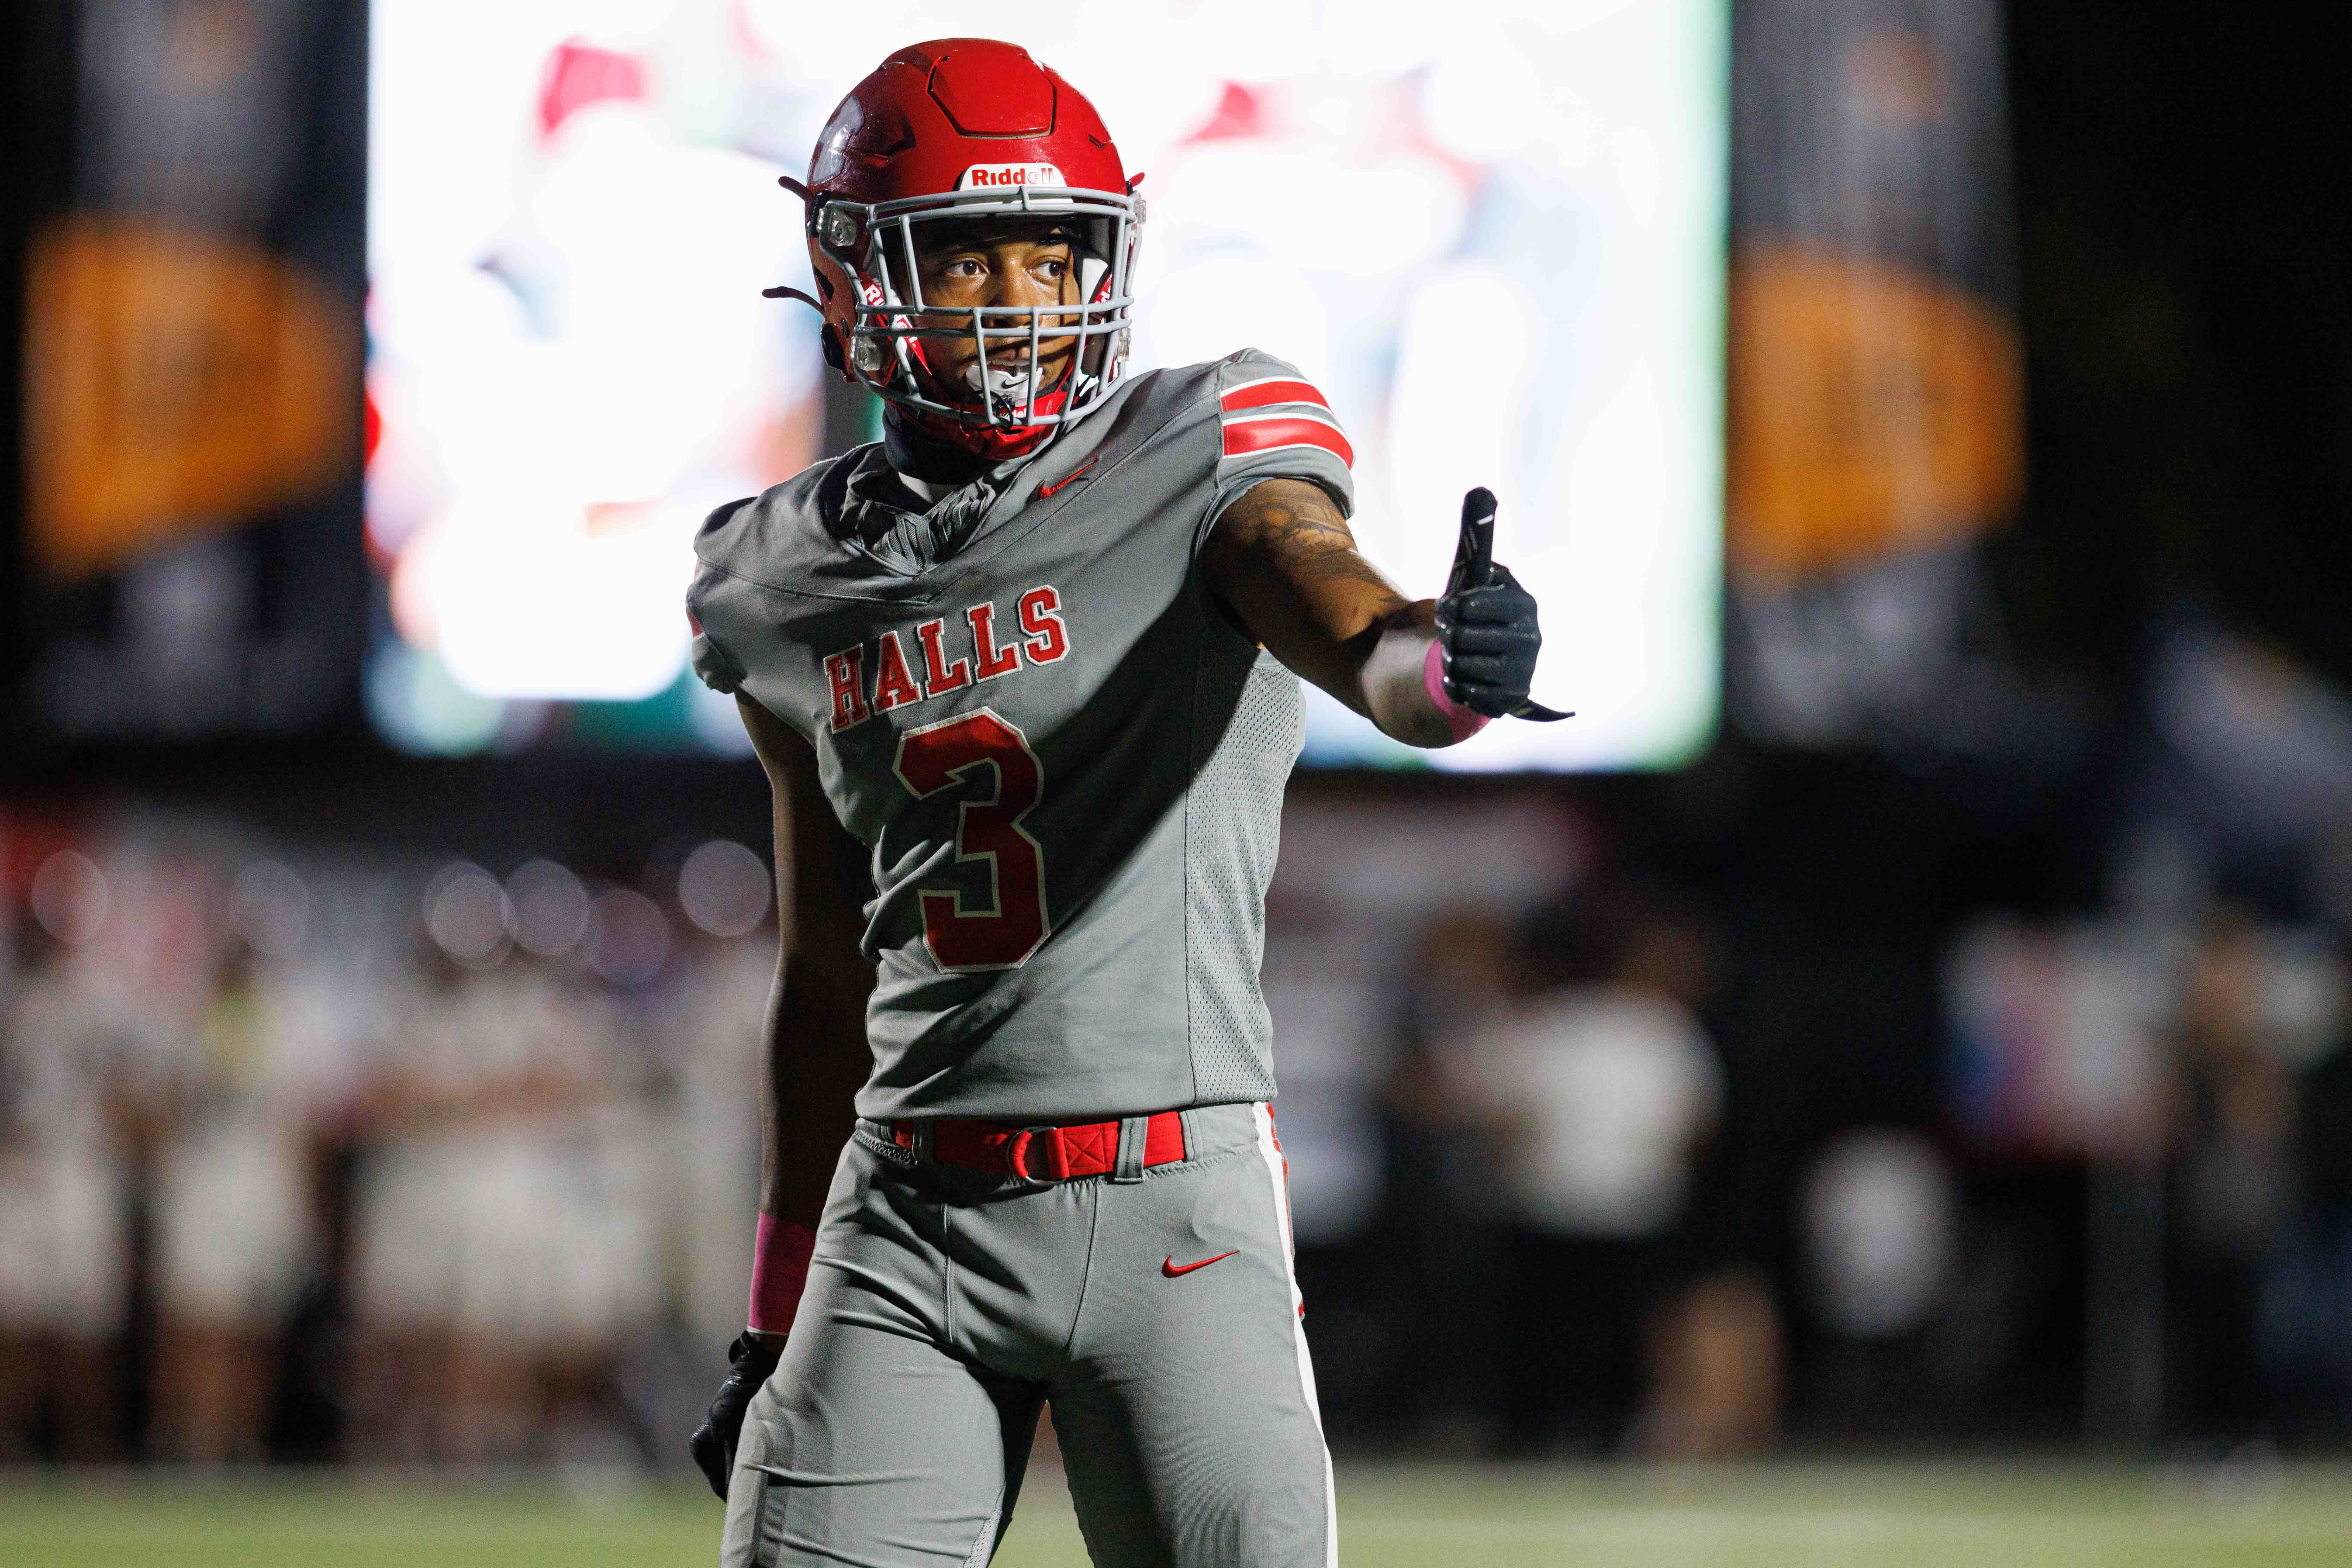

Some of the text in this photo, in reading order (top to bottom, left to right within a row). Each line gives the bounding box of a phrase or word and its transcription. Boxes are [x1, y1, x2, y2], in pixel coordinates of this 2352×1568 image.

[972, 168, 1055, 186] Riddell
[823, 584, 1070, 734] HALLS
[892, 706, 1051, 974] 3
